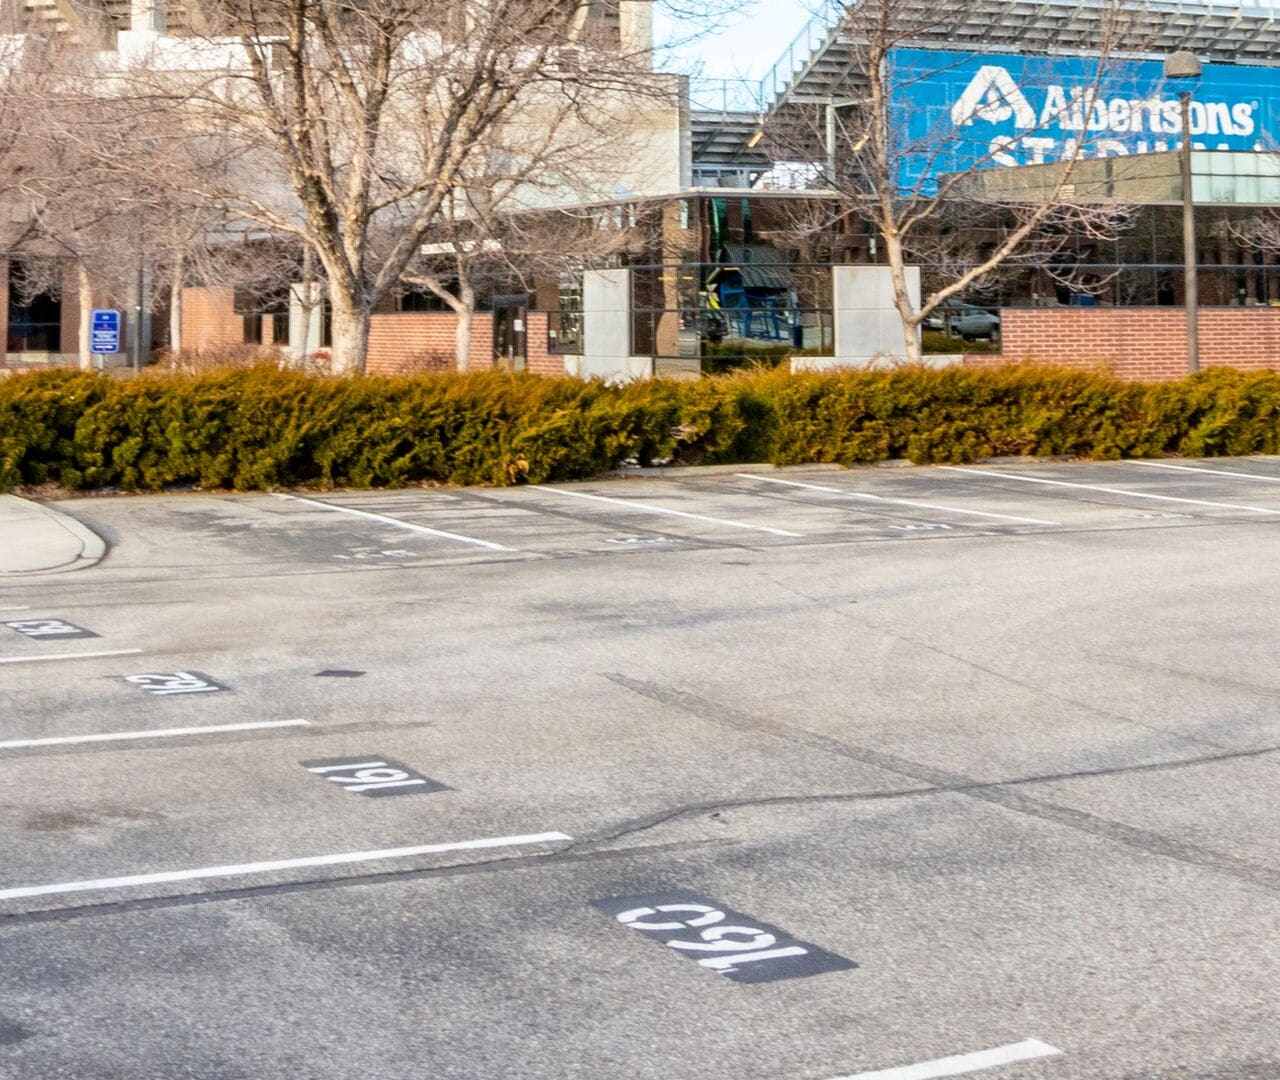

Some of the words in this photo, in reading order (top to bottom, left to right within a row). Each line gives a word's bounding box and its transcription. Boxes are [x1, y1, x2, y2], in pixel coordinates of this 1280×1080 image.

[1039, 84, 1256, 137] Albertsons
[5, 620, 83, 636] 163
[125, 671, 220, 695] 162
[306, 761, 427, 792] 161
[616, 903, 809, 973] 160
